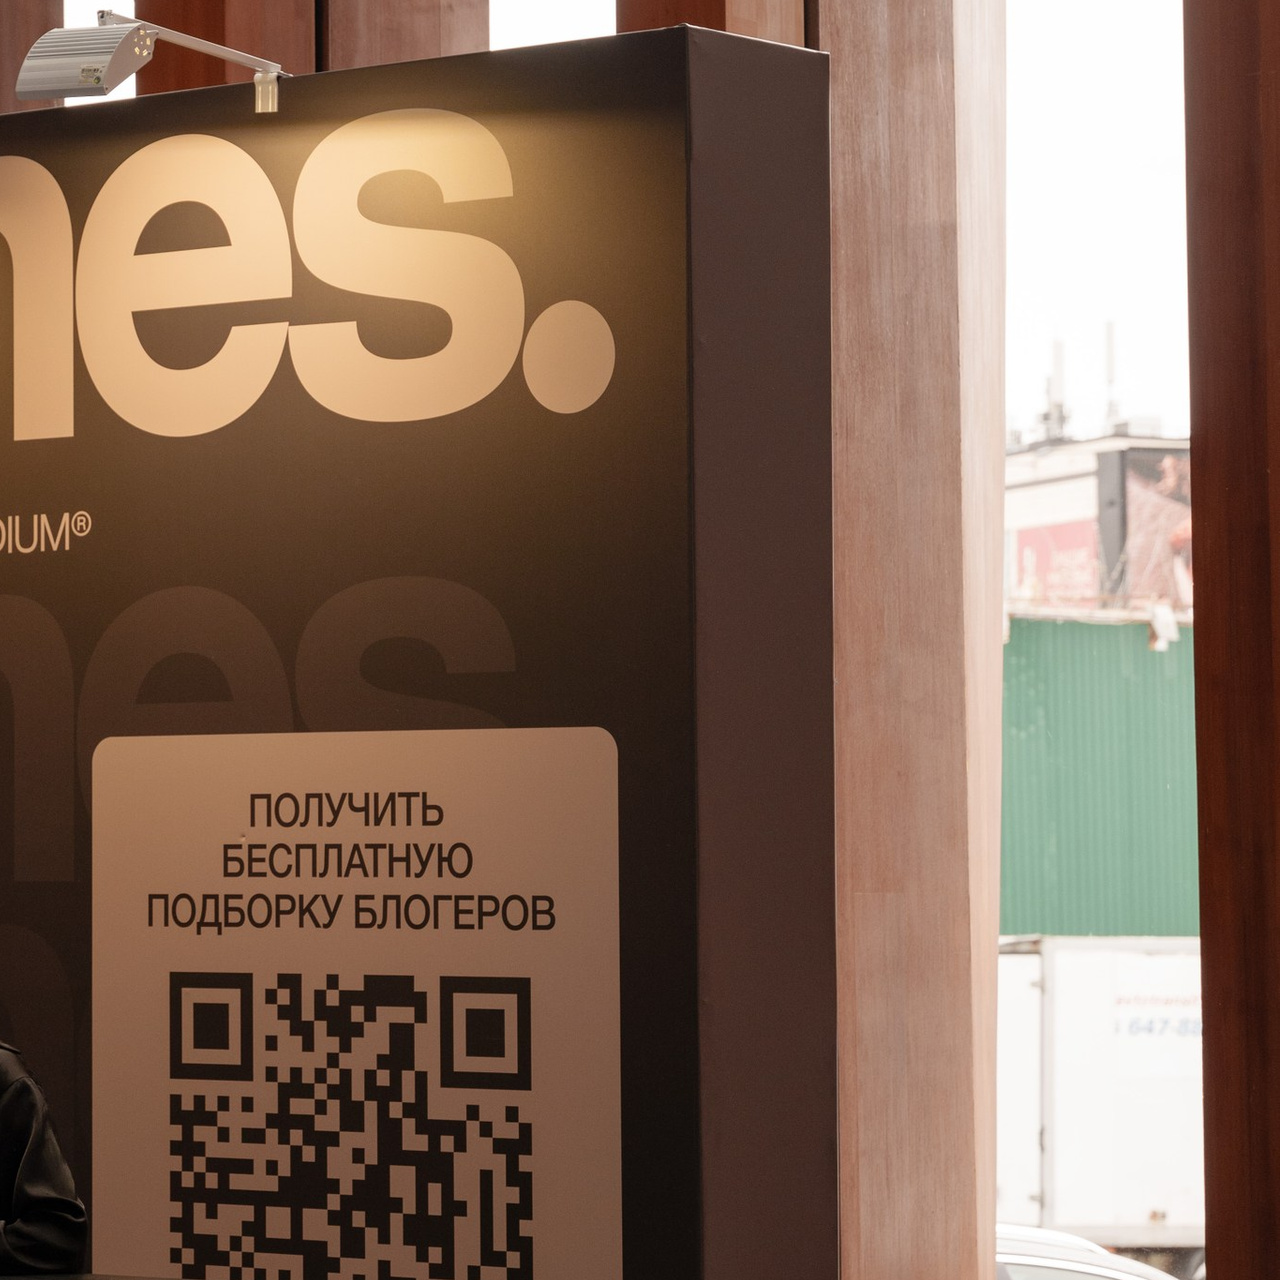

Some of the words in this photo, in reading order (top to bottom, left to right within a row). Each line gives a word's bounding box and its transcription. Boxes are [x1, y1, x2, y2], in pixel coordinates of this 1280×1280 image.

[249, 791, 445, 828] ПОЛУЧИТЬ
[222, 842, 473, 879] БЕСПЛАТНУЮ
[147, 893, 344, 936] ПОДБОРКУ
[354, 894, 557, 931] БЛОГЕРОВ
